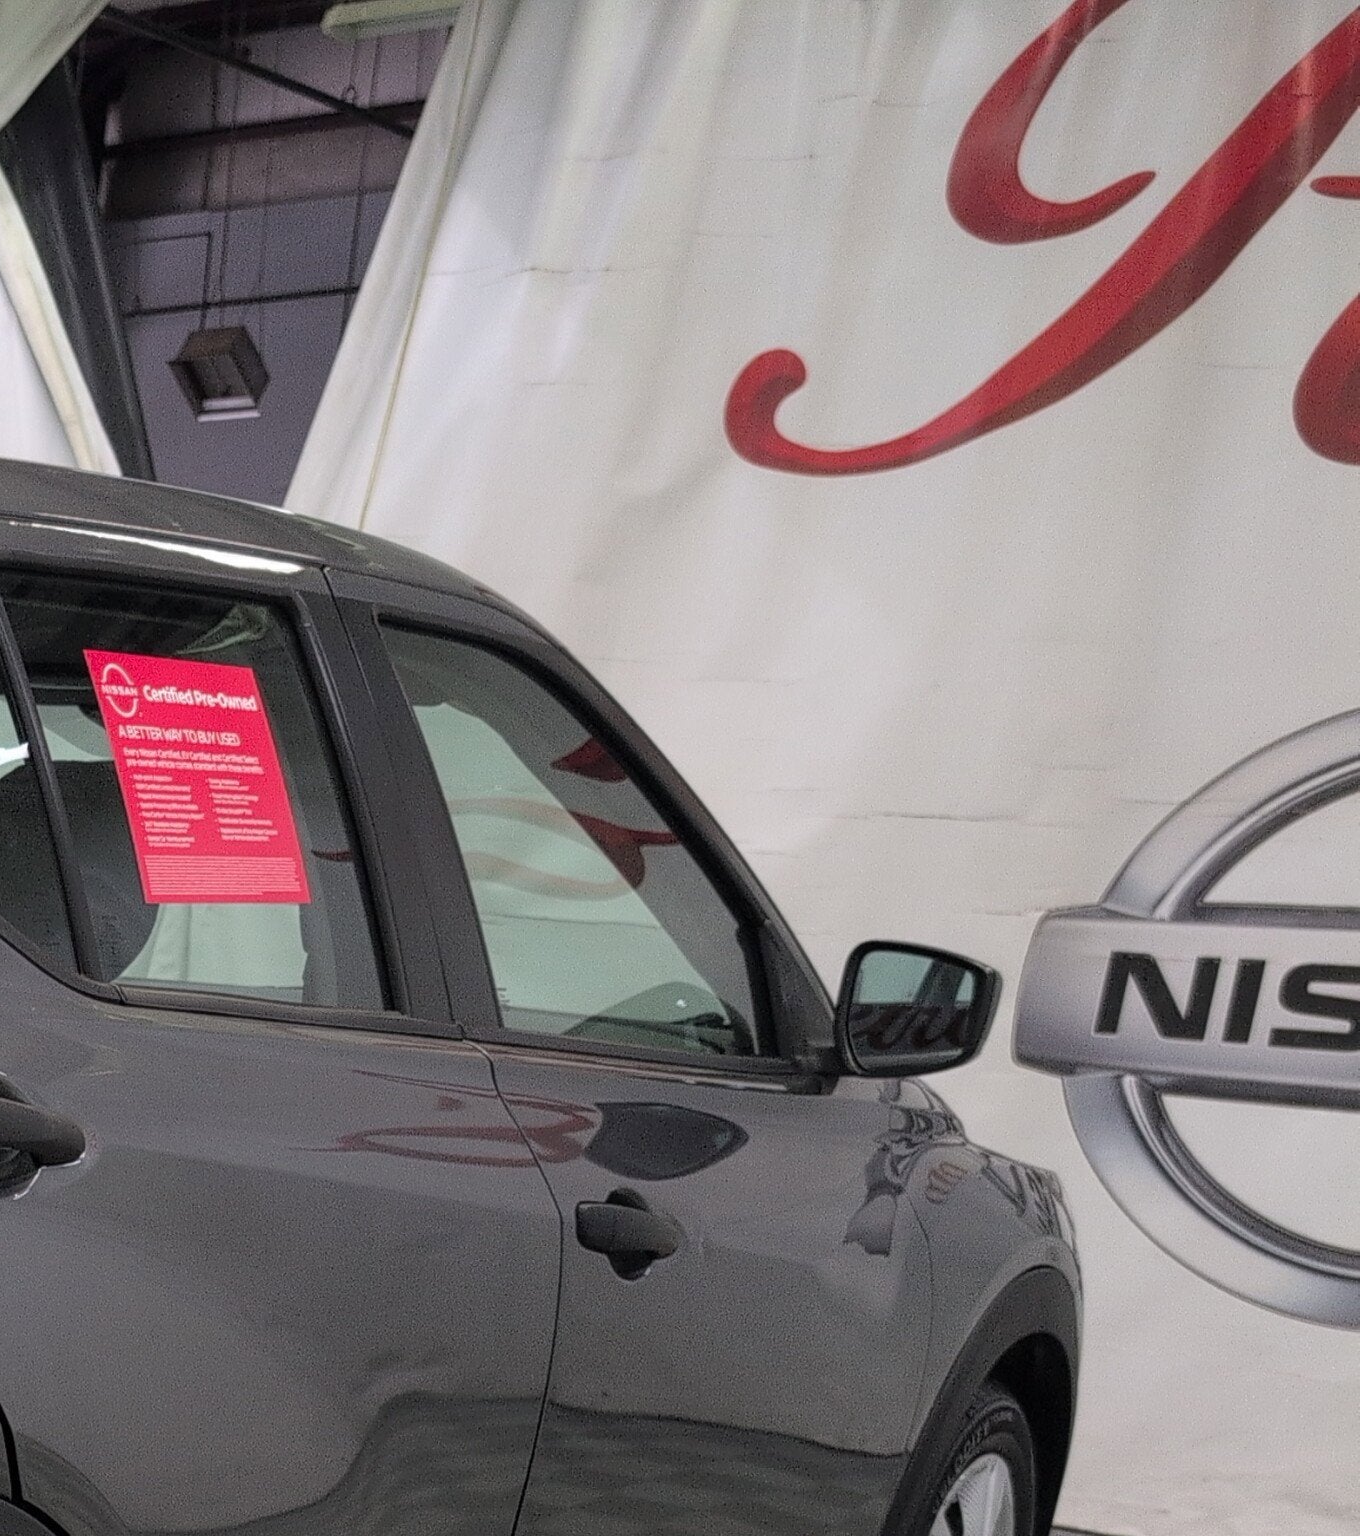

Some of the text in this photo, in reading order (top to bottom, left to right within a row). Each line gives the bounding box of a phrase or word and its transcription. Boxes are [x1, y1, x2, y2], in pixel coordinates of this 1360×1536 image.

[143, 685, 258, 711] Certified Pre-Owned
[127, 724, 163, 741] BETTER
